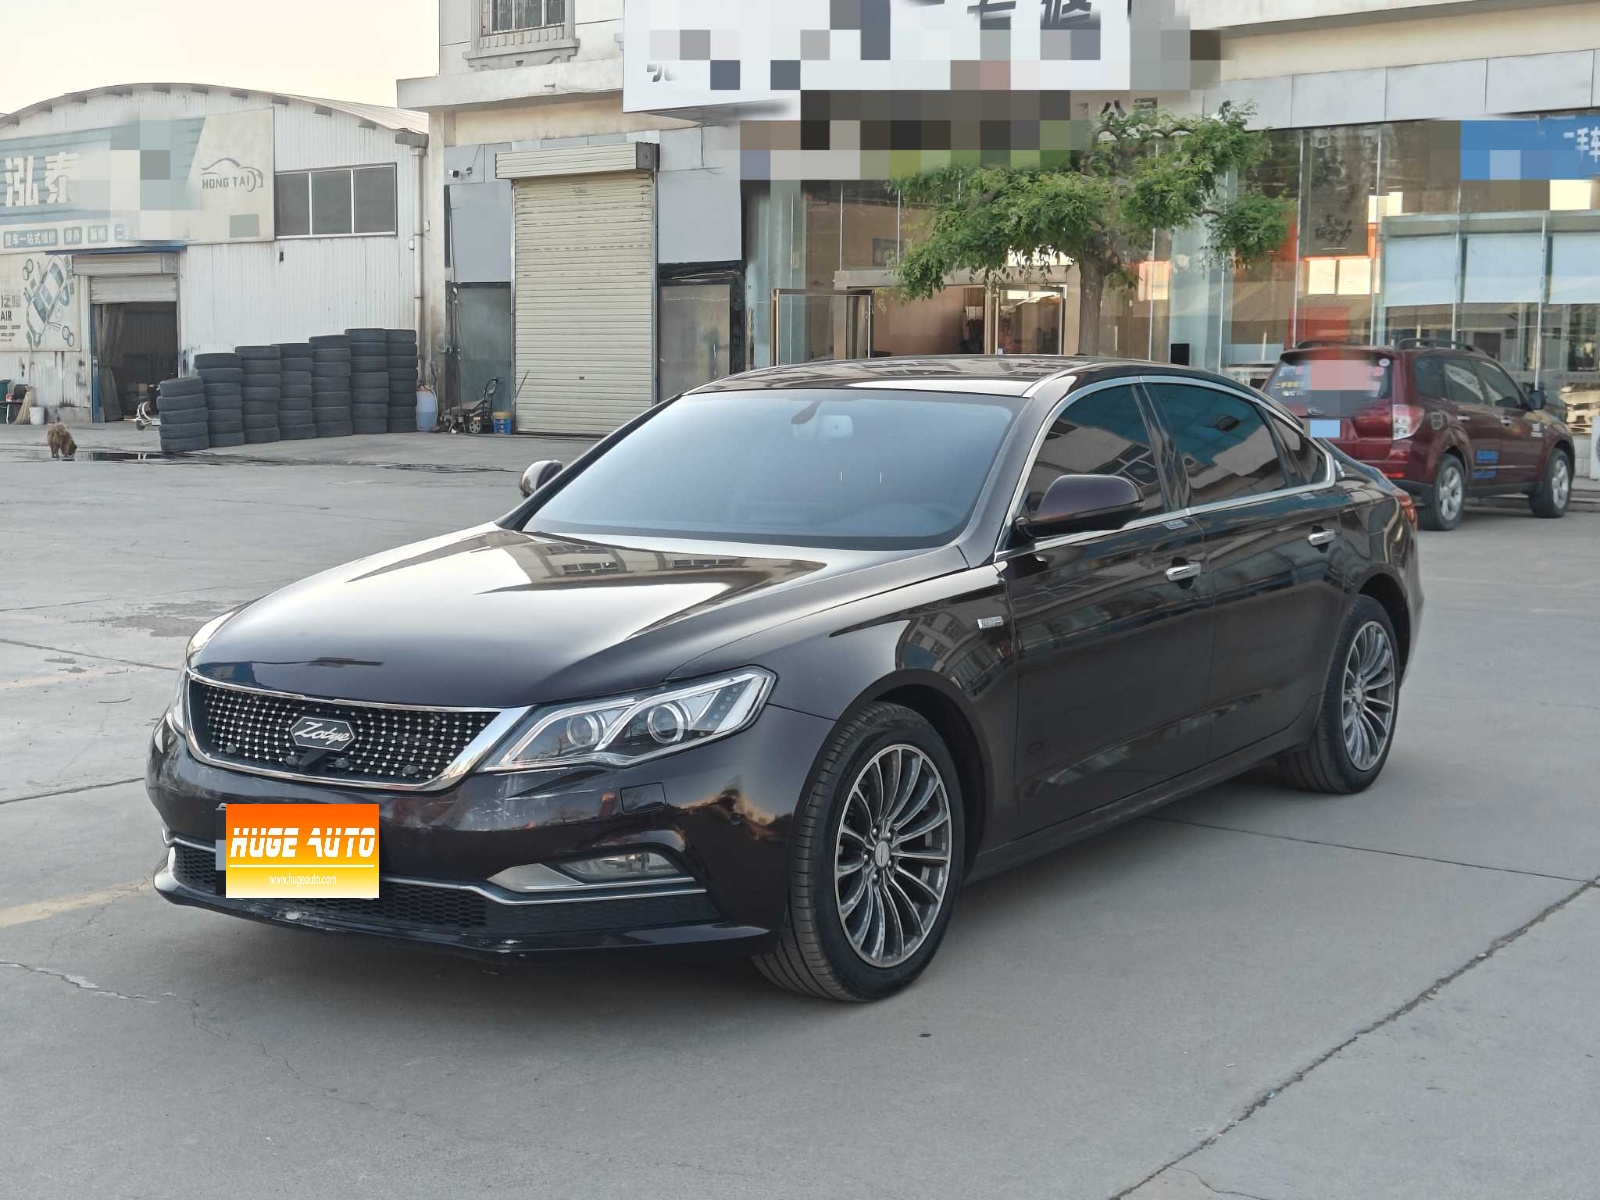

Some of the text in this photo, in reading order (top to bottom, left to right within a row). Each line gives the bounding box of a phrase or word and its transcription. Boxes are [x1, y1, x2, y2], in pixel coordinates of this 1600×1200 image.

[202, 174, 250, 189] HONG TAI
[294, 721, 350, 745] Zotye
